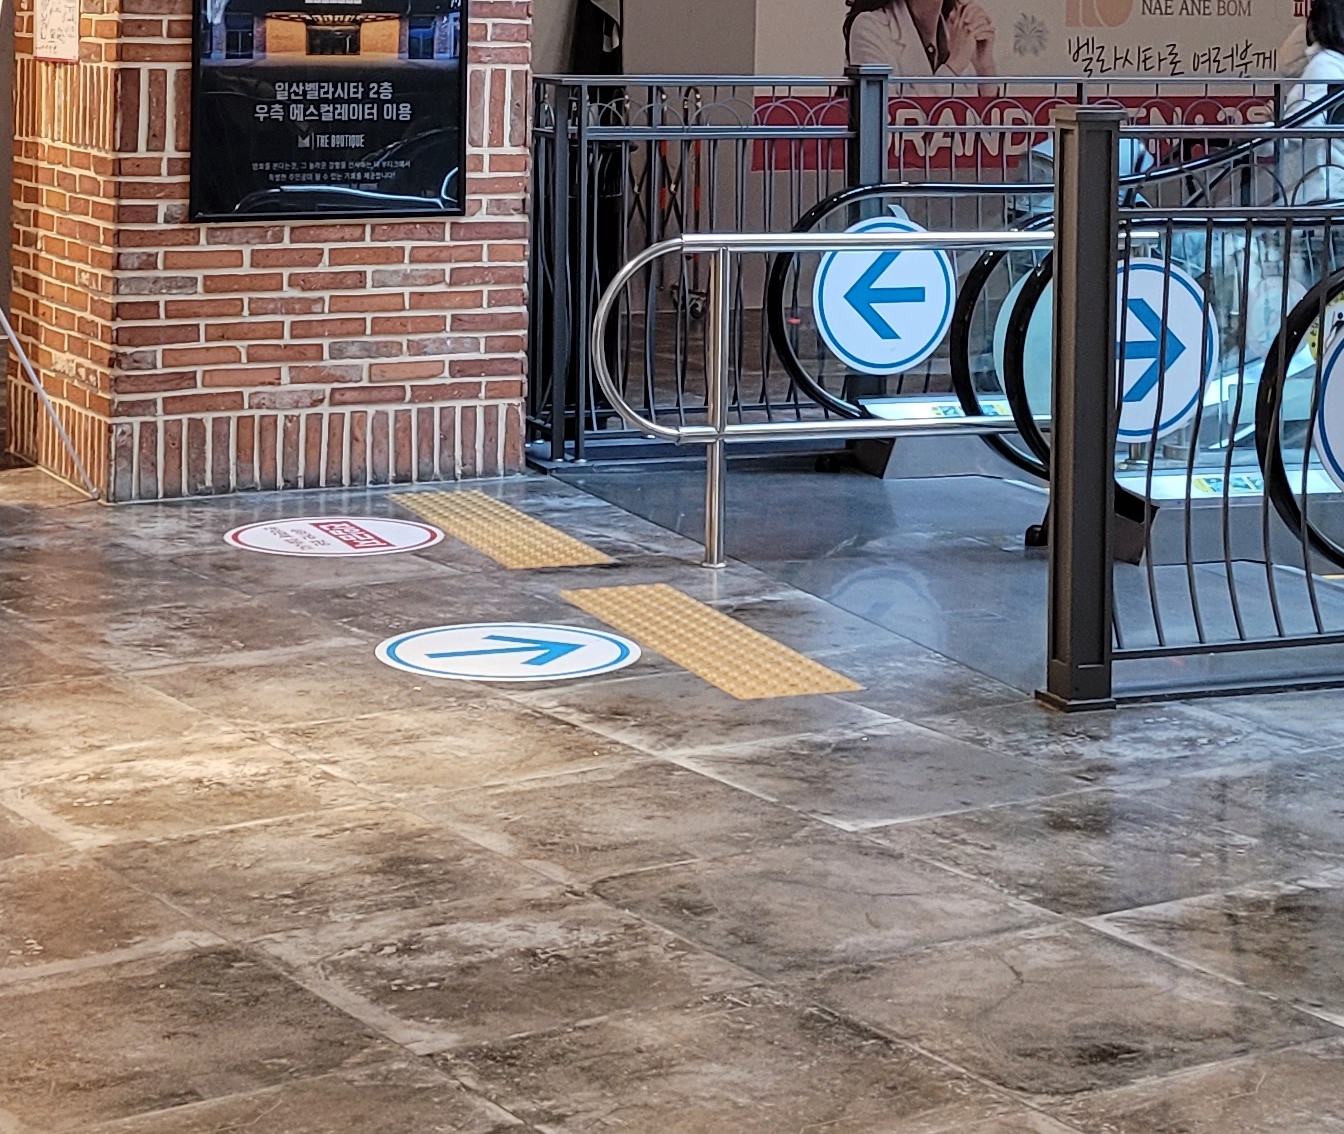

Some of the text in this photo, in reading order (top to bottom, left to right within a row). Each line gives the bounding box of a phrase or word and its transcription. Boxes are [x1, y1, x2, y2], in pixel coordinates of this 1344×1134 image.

[1216, 0, 1251, 17] BOM
[1067, 36, 1278, 78] 벨라시타로 여러분께
[275, 81, 393, 100] 일산벨라시타 2층
[254, 102, 412, 122] 우측 에스컬레이터 이용
[316, 133, 366, 149] THE BOUTIQUE
